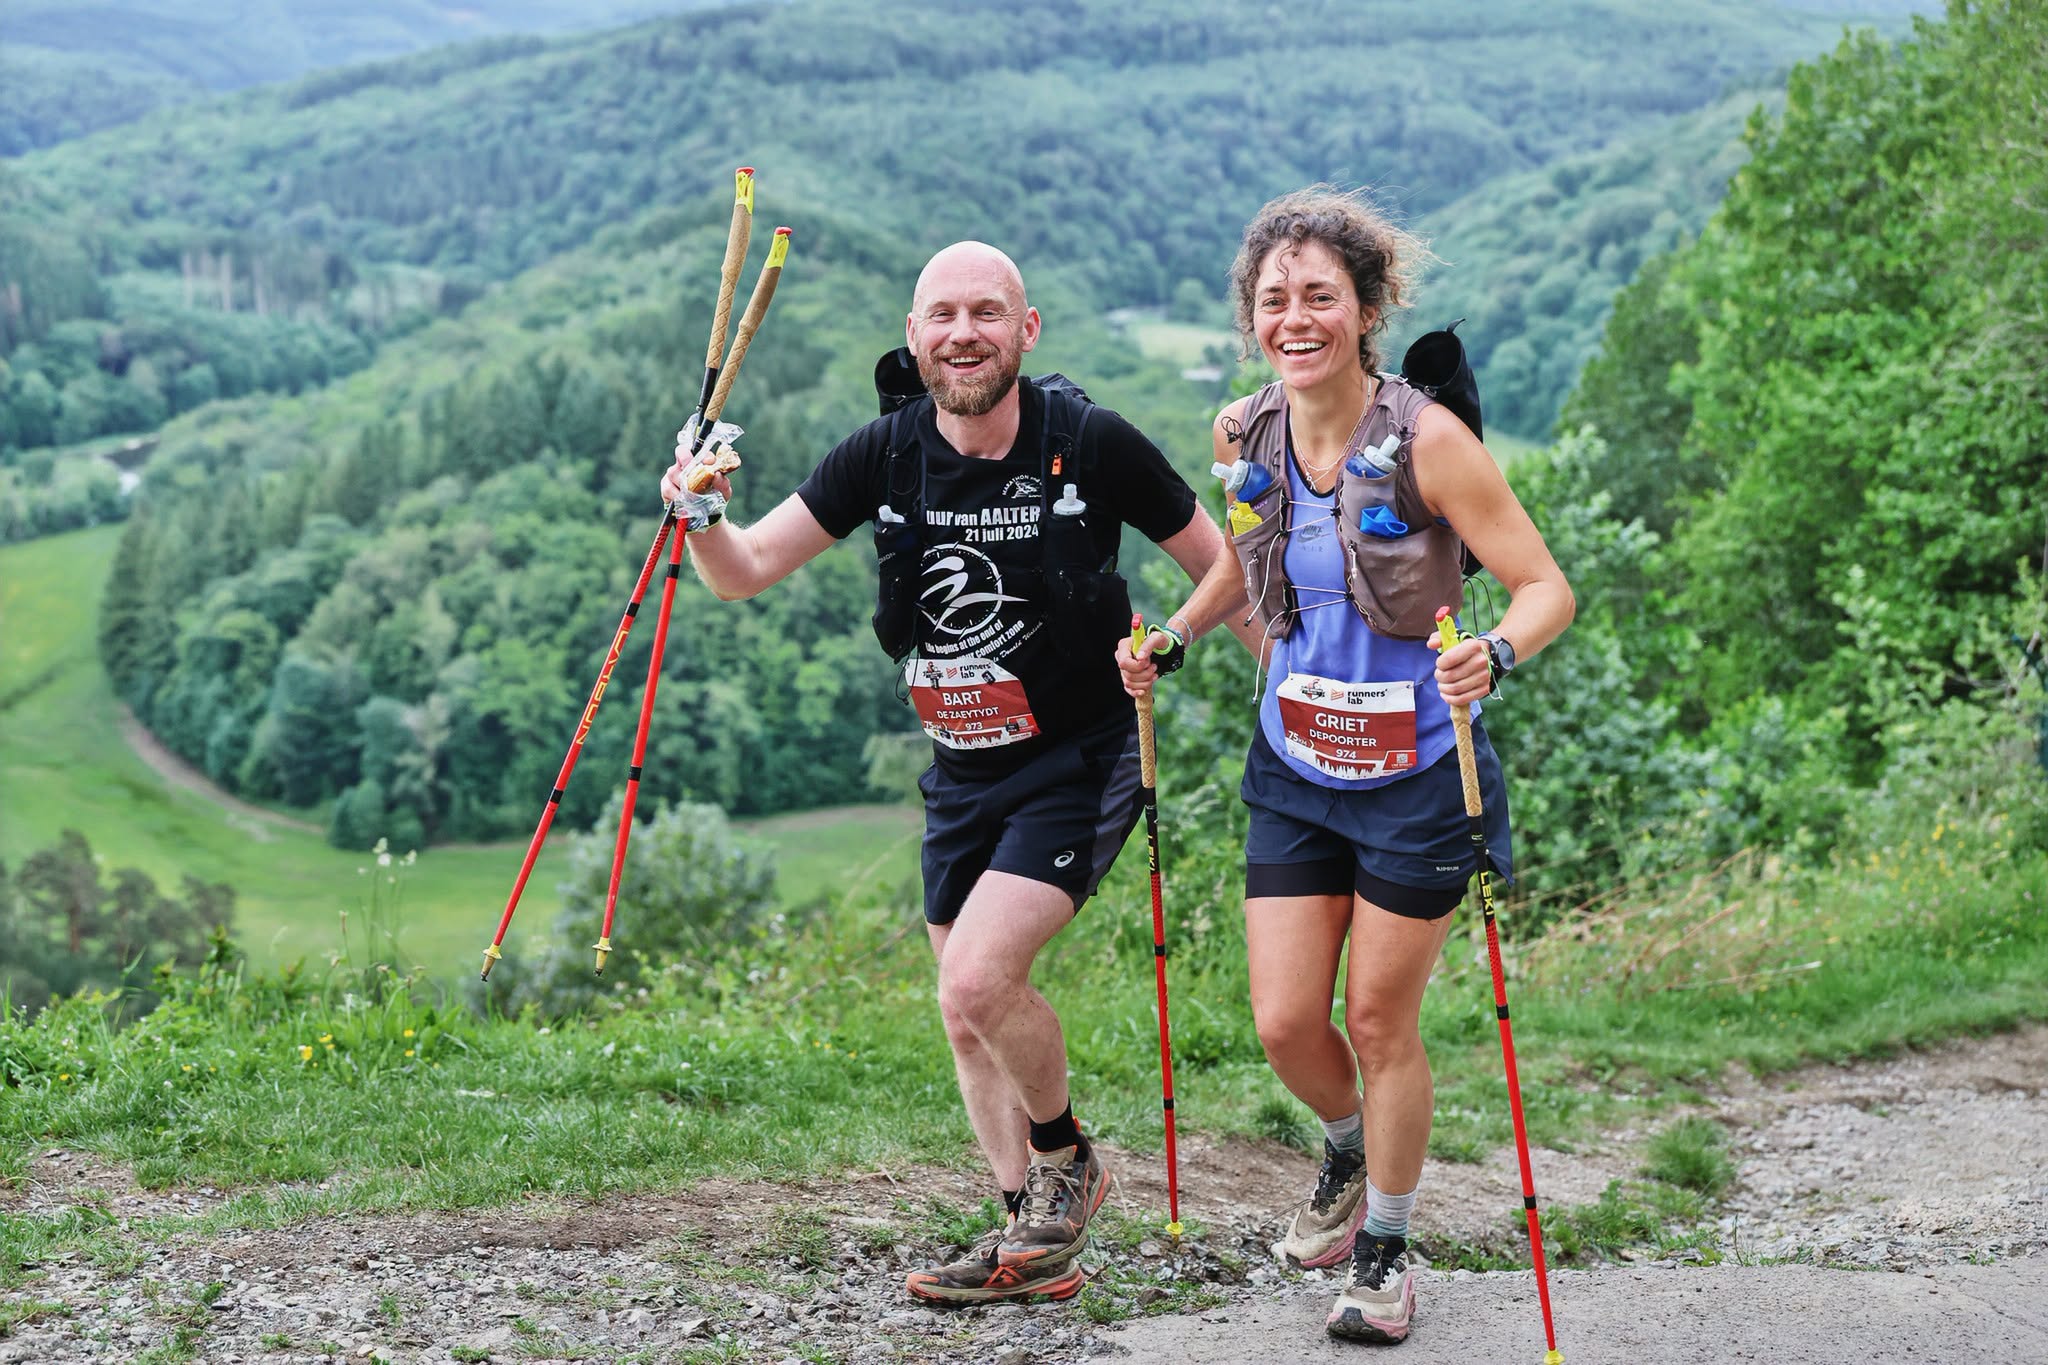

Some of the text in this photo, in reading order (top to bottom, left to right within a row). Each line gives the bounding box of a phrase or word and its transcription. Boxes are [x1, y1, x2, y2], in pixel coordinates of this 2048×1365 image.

[926, 505, 1041, 526] uur van AALTER
[965, 524, 1039, 543] 21 juli 2024
[959, 639, 968, 650] at
[967, 633, 981, 648] the
[980, 625, 996, 641] end
[994, 619, 1004, 631] of
[976, 632, 1008, 659] comfort
[1005, 620, 1025, 640] zone
[961, 671, 975, 679] lab
[942, 690, 982, 706] BART
[1347, 697, 1363, 705] lab
[936, 706, 999, 719] DE ZAEYTYDT
[965, 721, 983, 731] 973
[1314, 712, 1369, 733] GRIET
[1309, 728, 1377, 747] DEPOORTER
[1335, 749, 1357, 760] 974
[1480, 871, 1494, 916] LEKI
